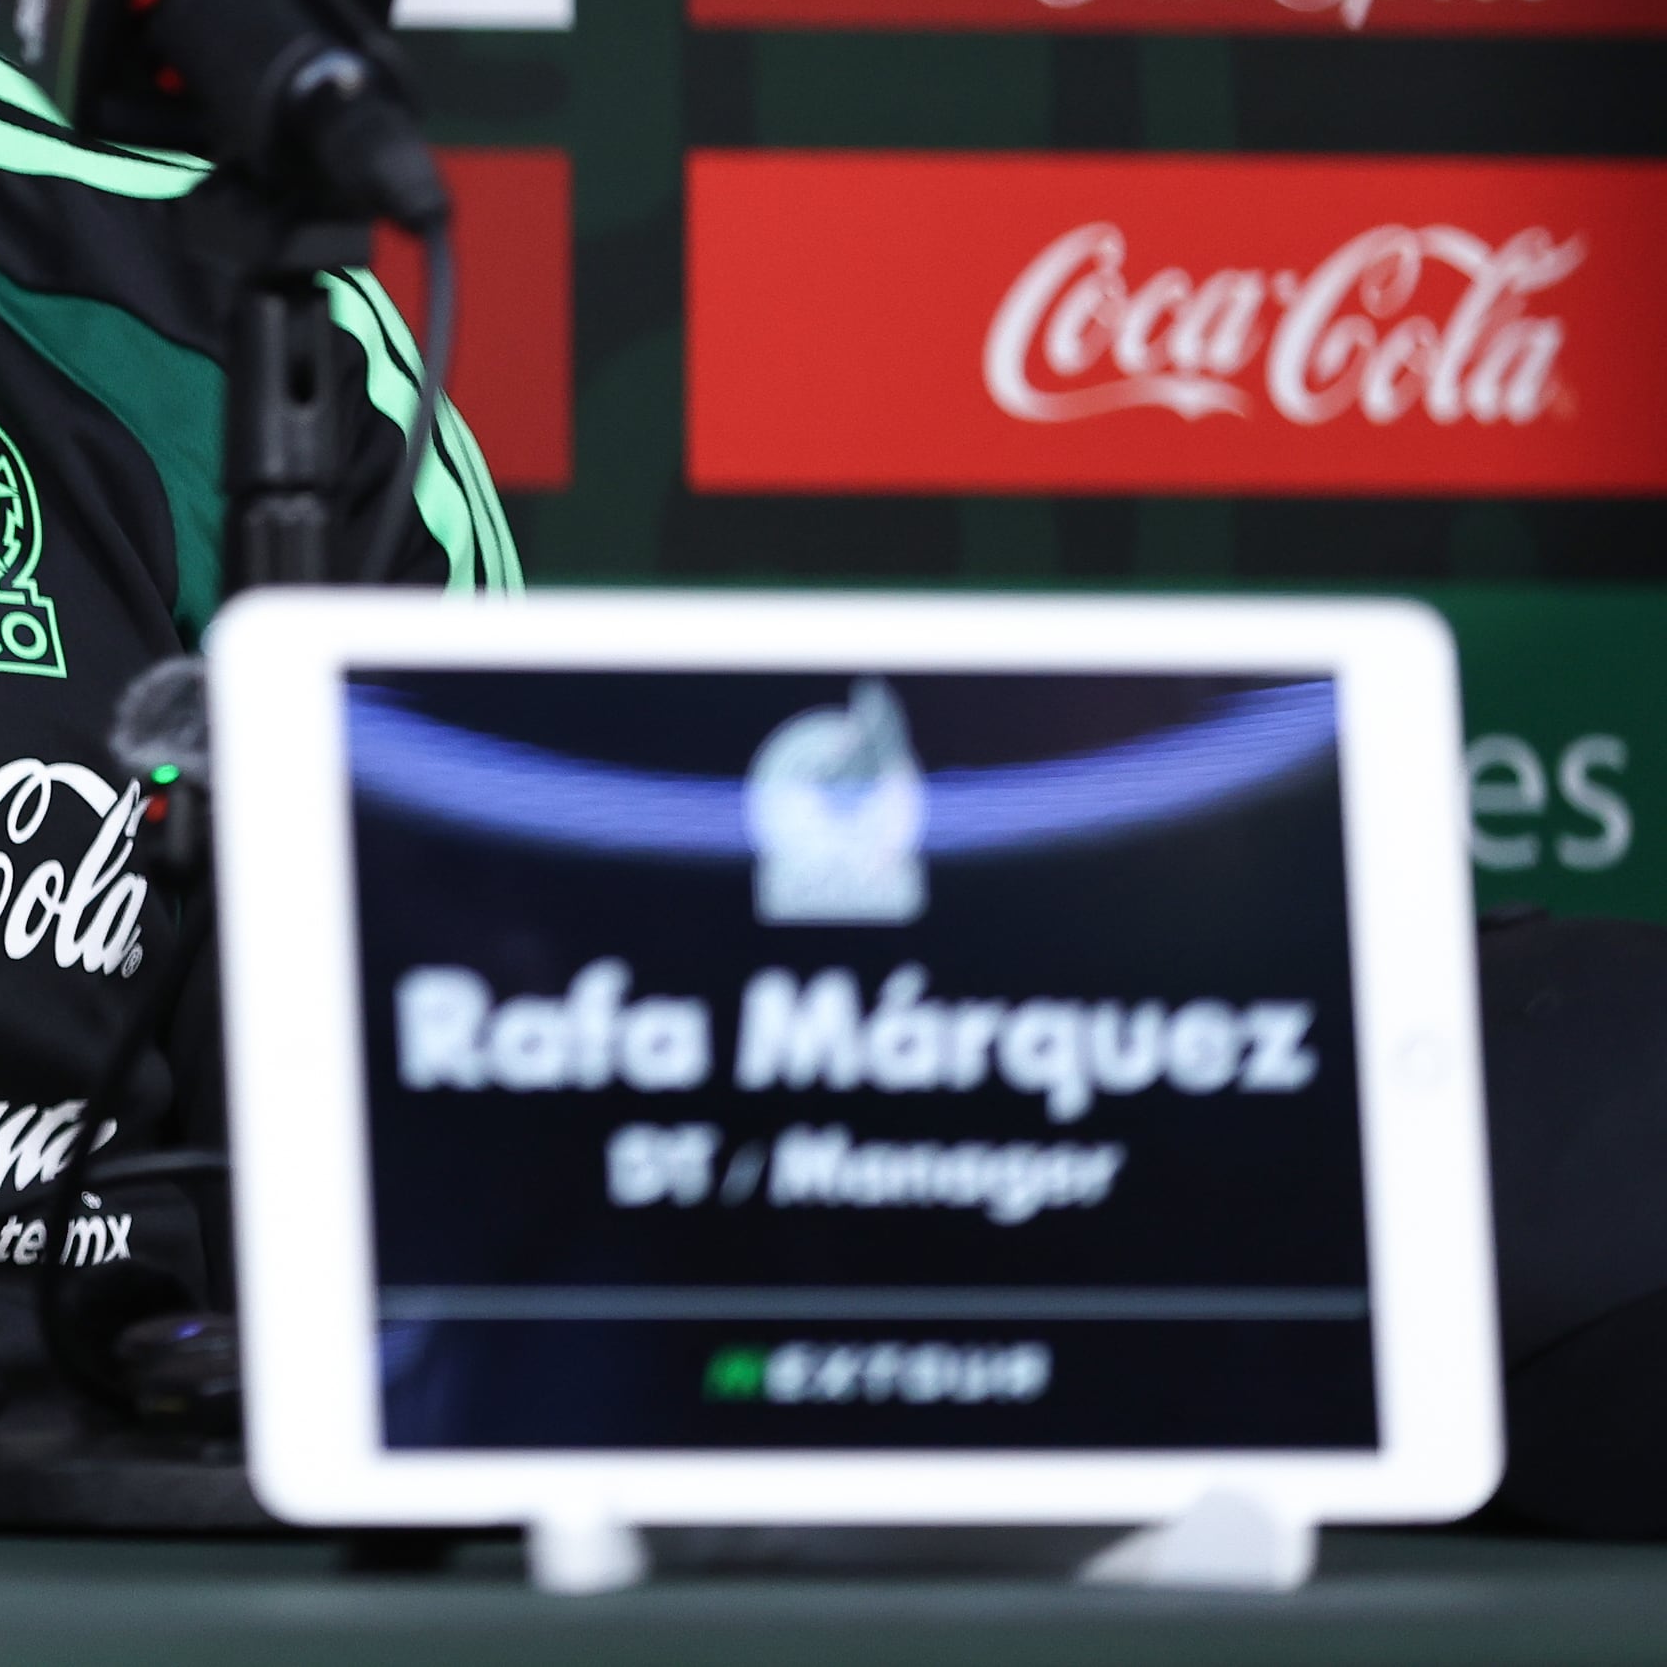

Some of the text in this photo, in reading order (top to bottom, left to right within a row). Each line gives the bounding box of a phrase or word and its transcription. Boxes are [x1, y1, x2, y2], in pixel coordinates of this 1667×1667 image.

[981, 220, 1589, 426] Coca-Cola
[395, 958, 1317, 1124] Rafa Márquez
